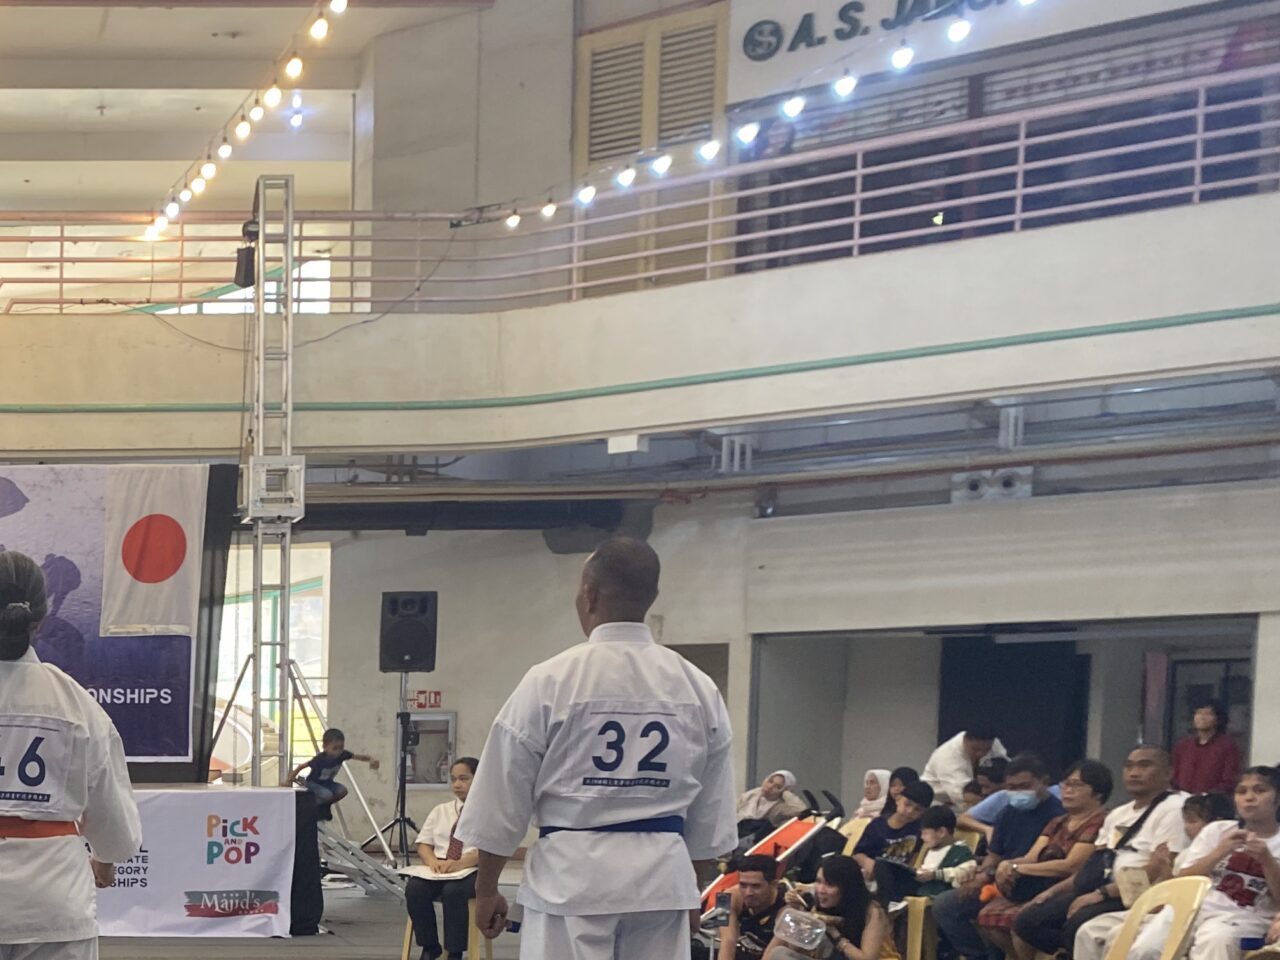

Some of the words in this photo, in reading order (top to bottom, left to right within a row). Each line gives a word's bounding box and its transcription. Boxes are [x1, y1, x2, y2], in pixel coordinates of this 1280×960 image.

[87, 688, 172, 704] ONSHIPS
[592, 720, 669, 772] 32
[207, 841, 260, 864] POP
[116, 866, 148, 875] GORY
